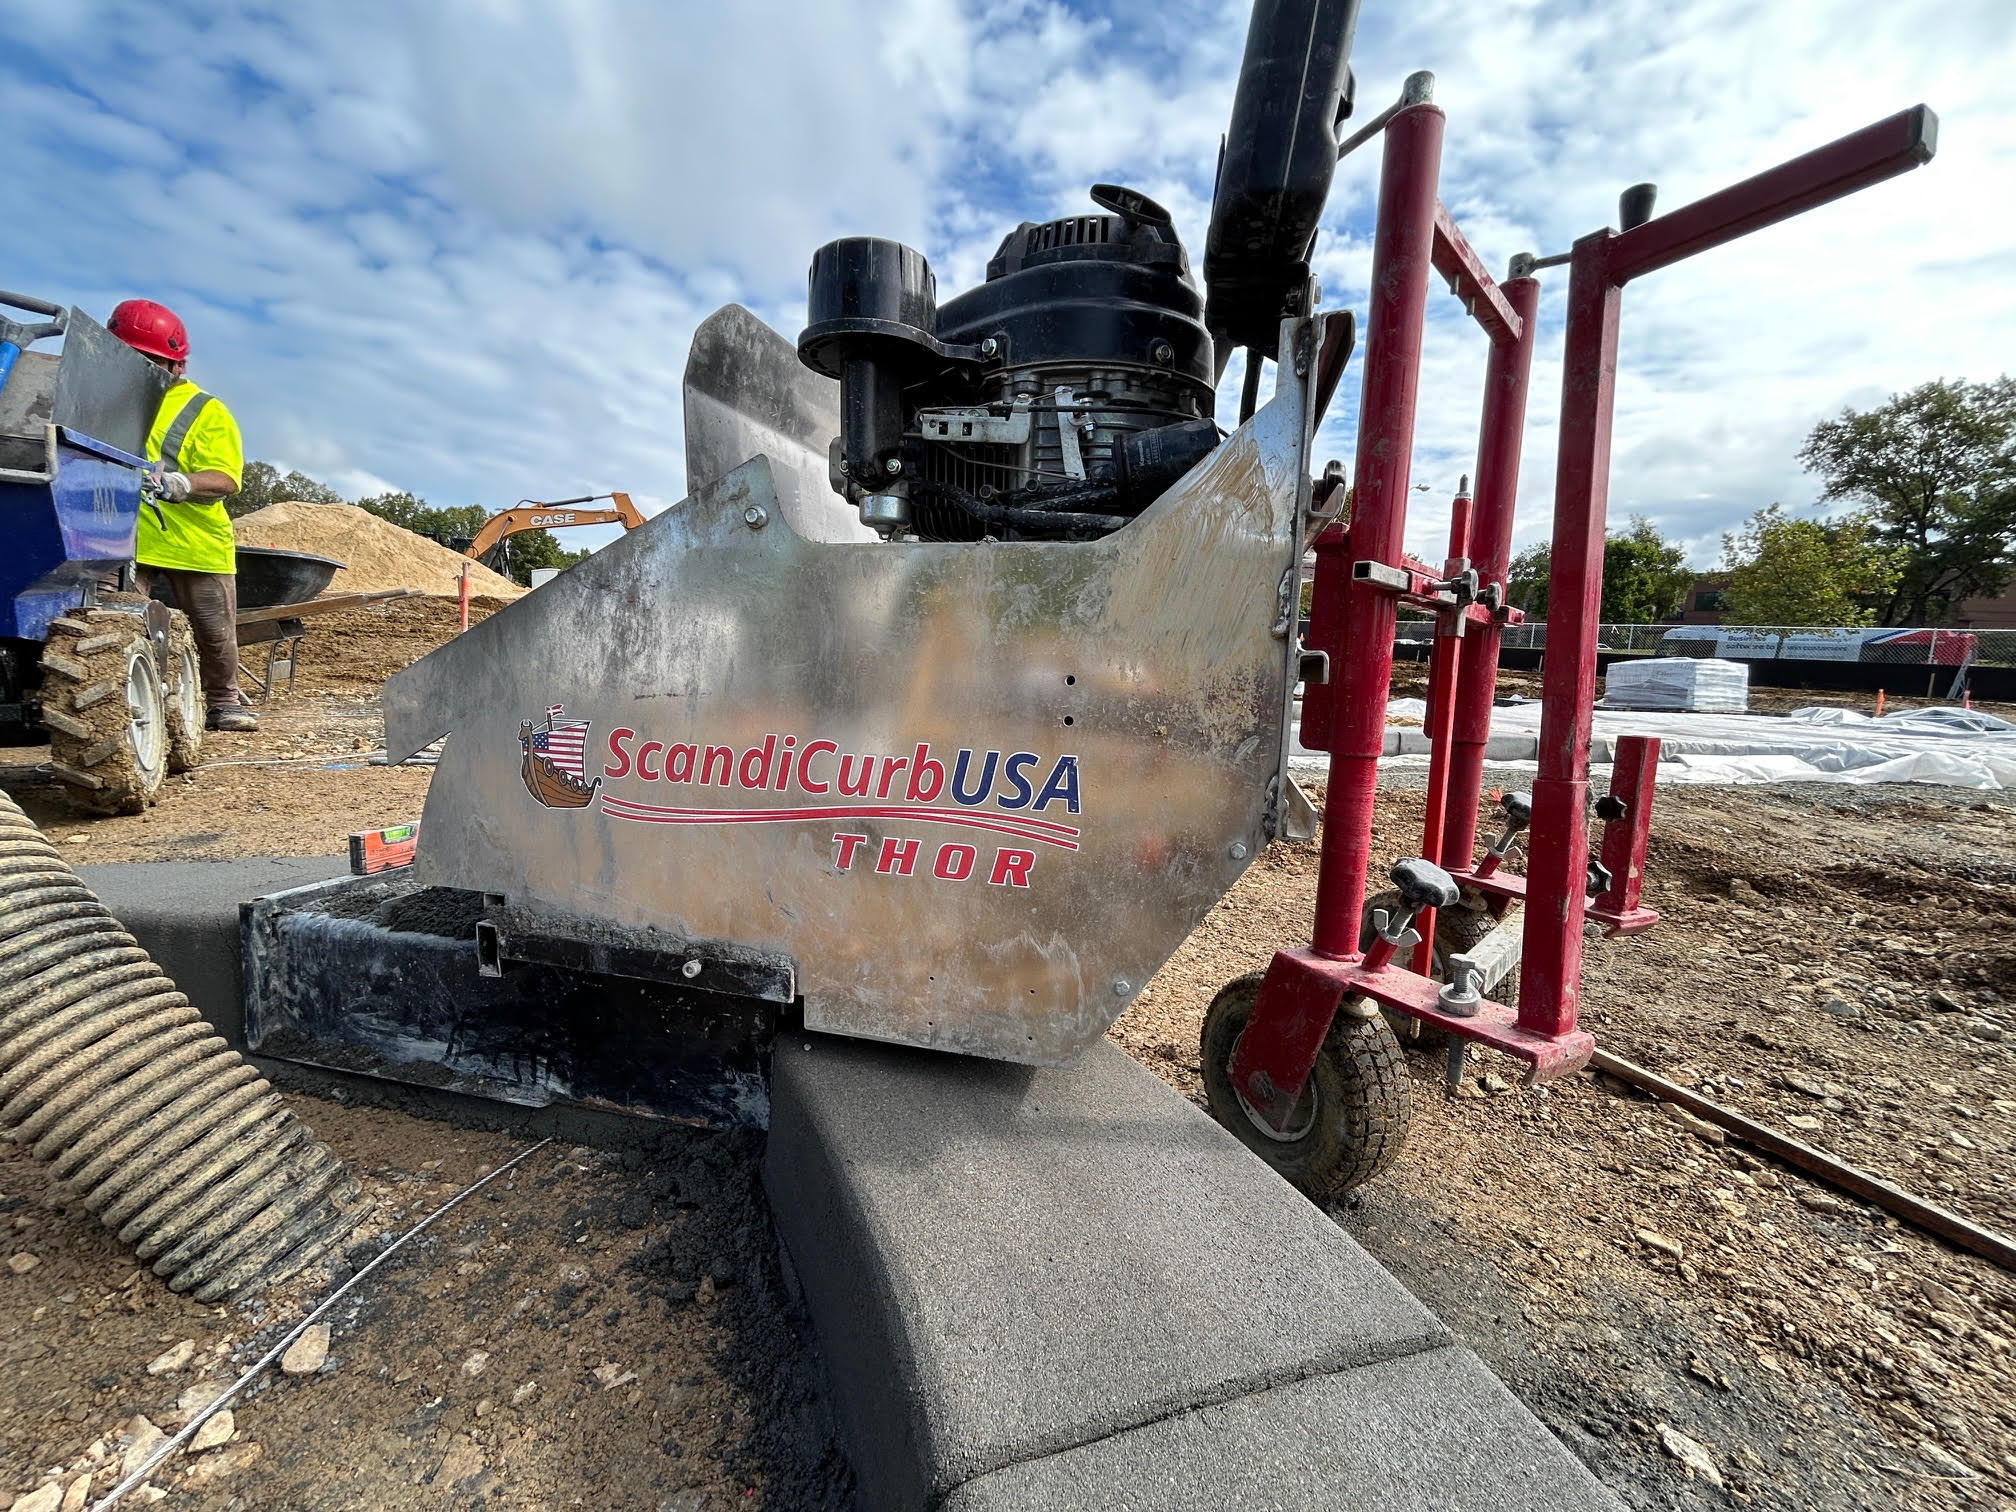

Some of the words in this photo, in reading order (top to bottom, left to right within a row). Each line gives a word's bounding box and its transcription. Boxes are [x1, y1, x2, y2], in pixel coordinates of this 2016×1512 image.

[530, 513, 575, 526] CASE
[603, 727, 1082, 814] ScandiCurbUSA
[832, 832, 1036, 888] THOR
